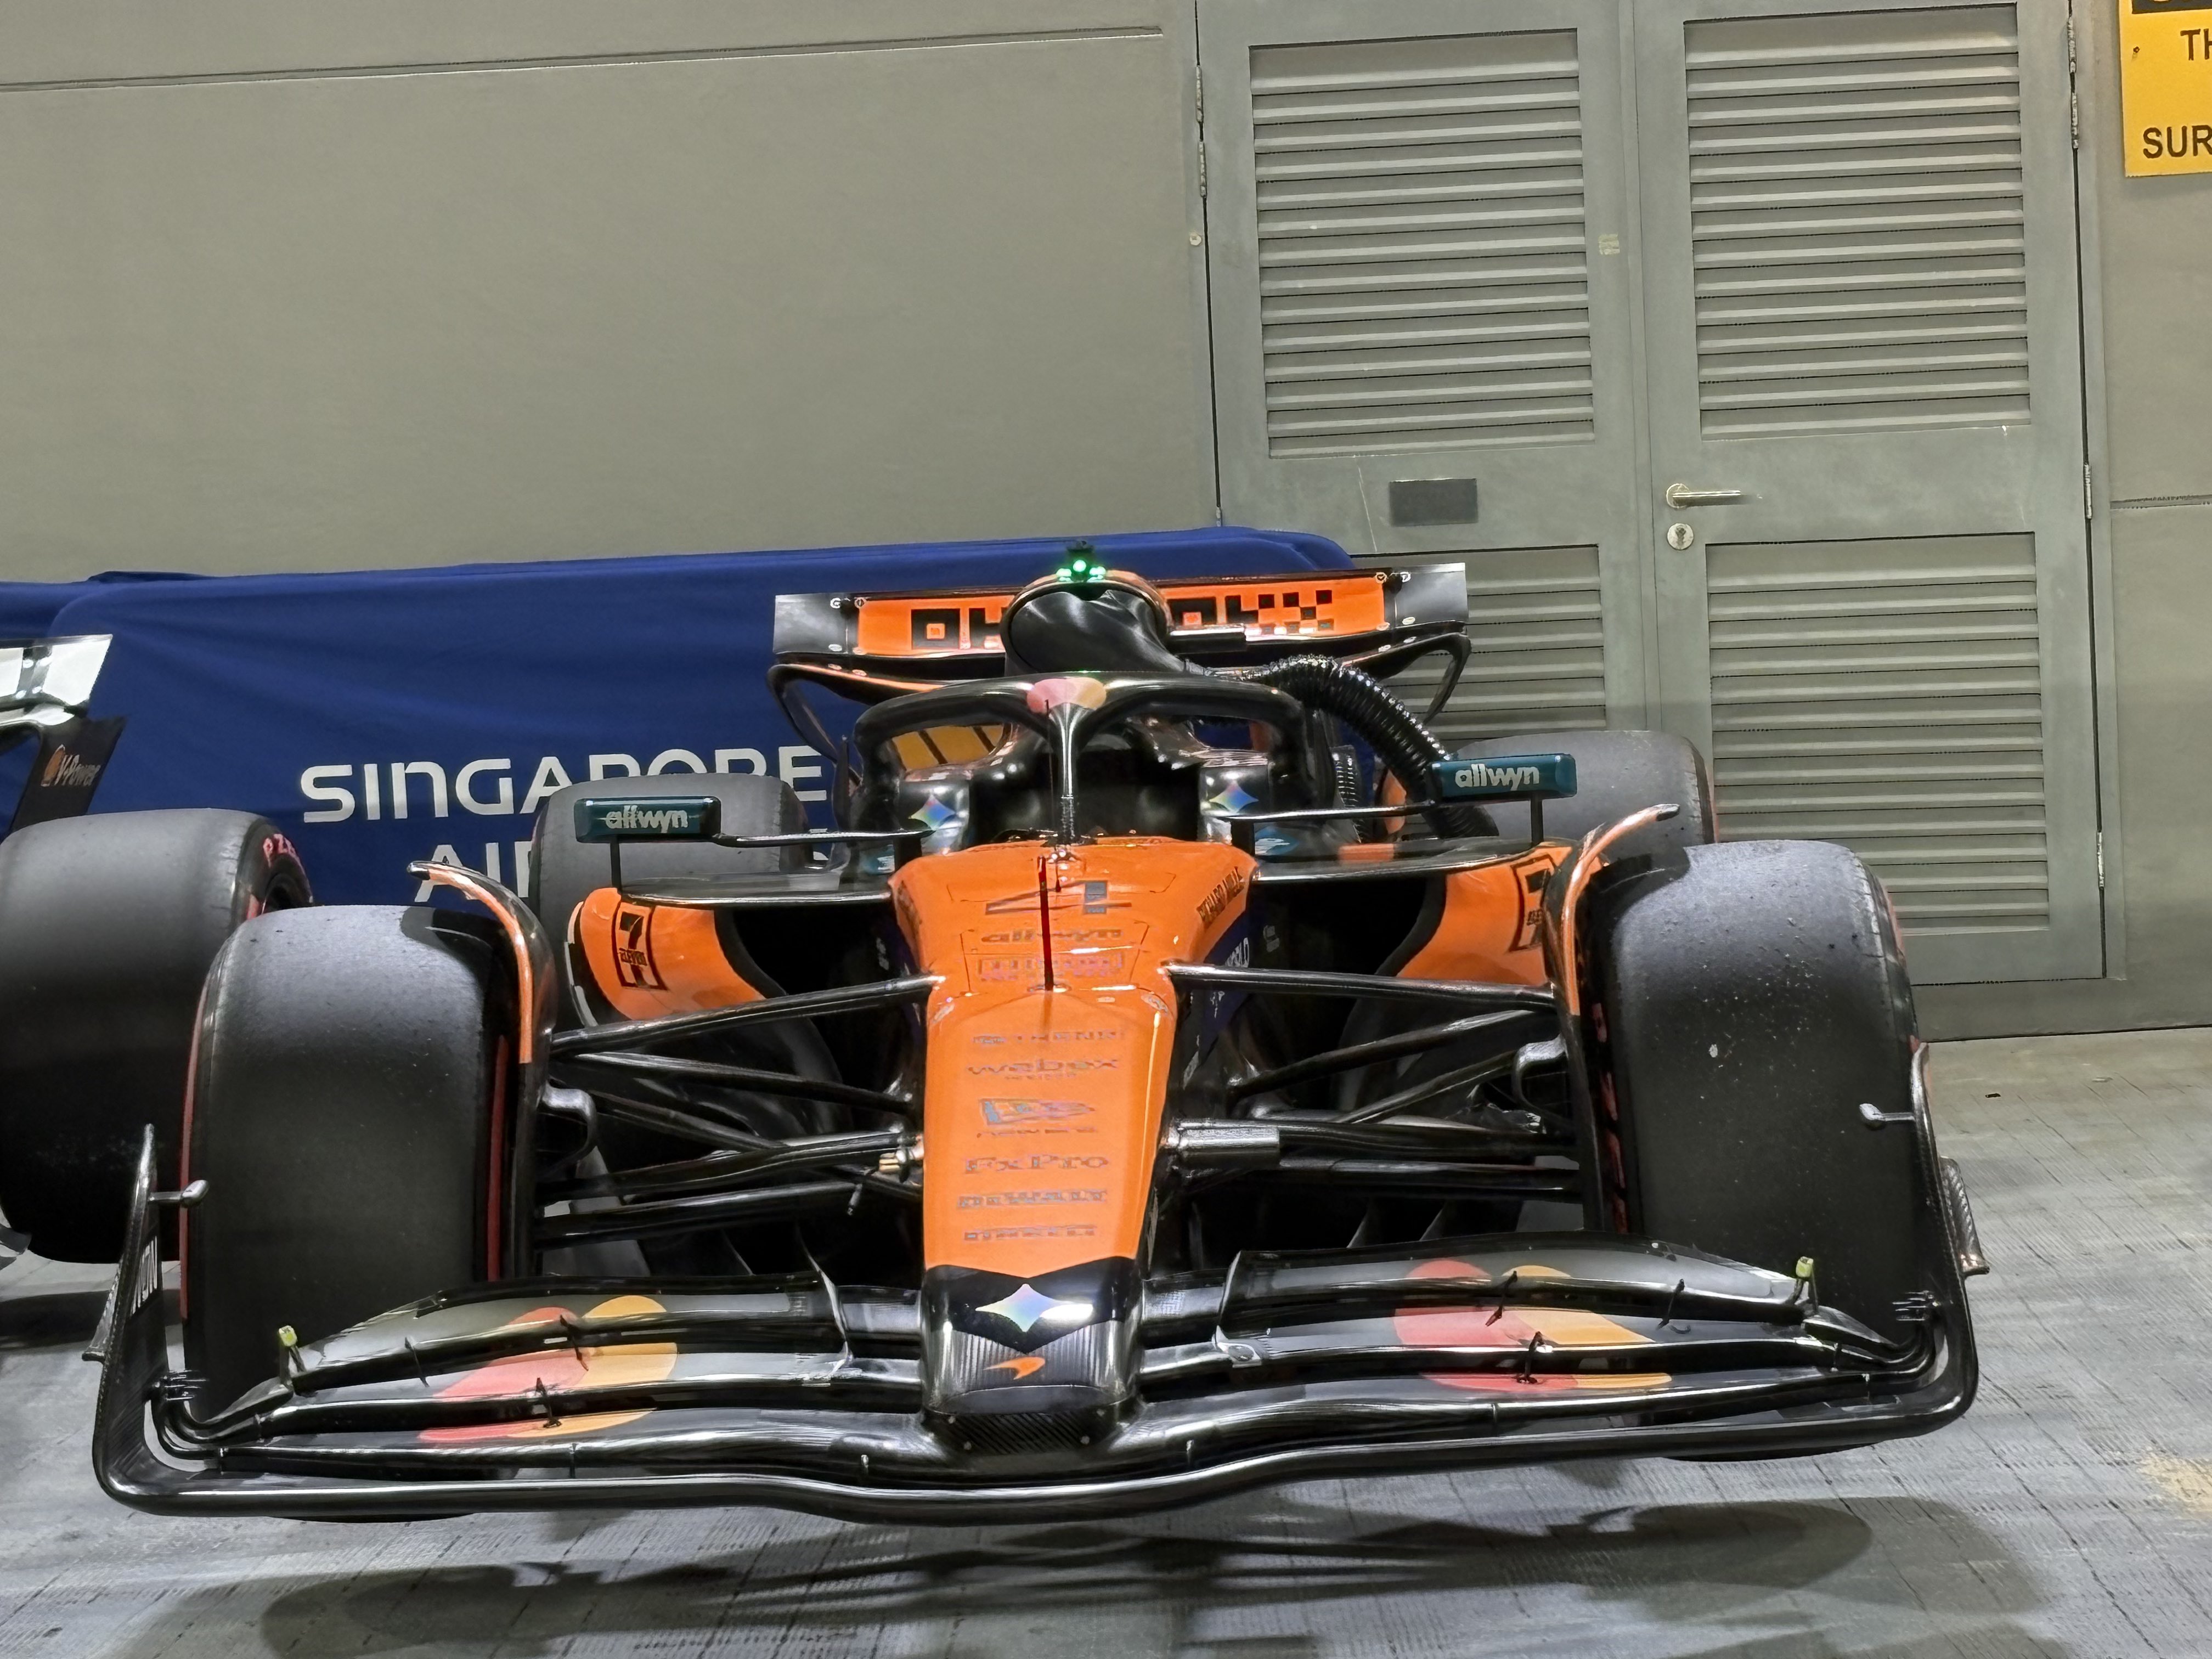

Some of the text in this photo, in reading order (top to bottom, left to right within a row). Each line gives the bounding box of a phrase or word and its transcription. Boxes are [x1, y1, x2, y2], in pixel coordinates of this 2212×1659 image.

[2143, 125, 2212, 159] SUR
[1455, 763, 1539, 791] allwyn
[606, 805, 688, 833] allwyn
[967, 1058, 1118, 1075] webex
[966, 1153, 1109, 1174] FxPro
